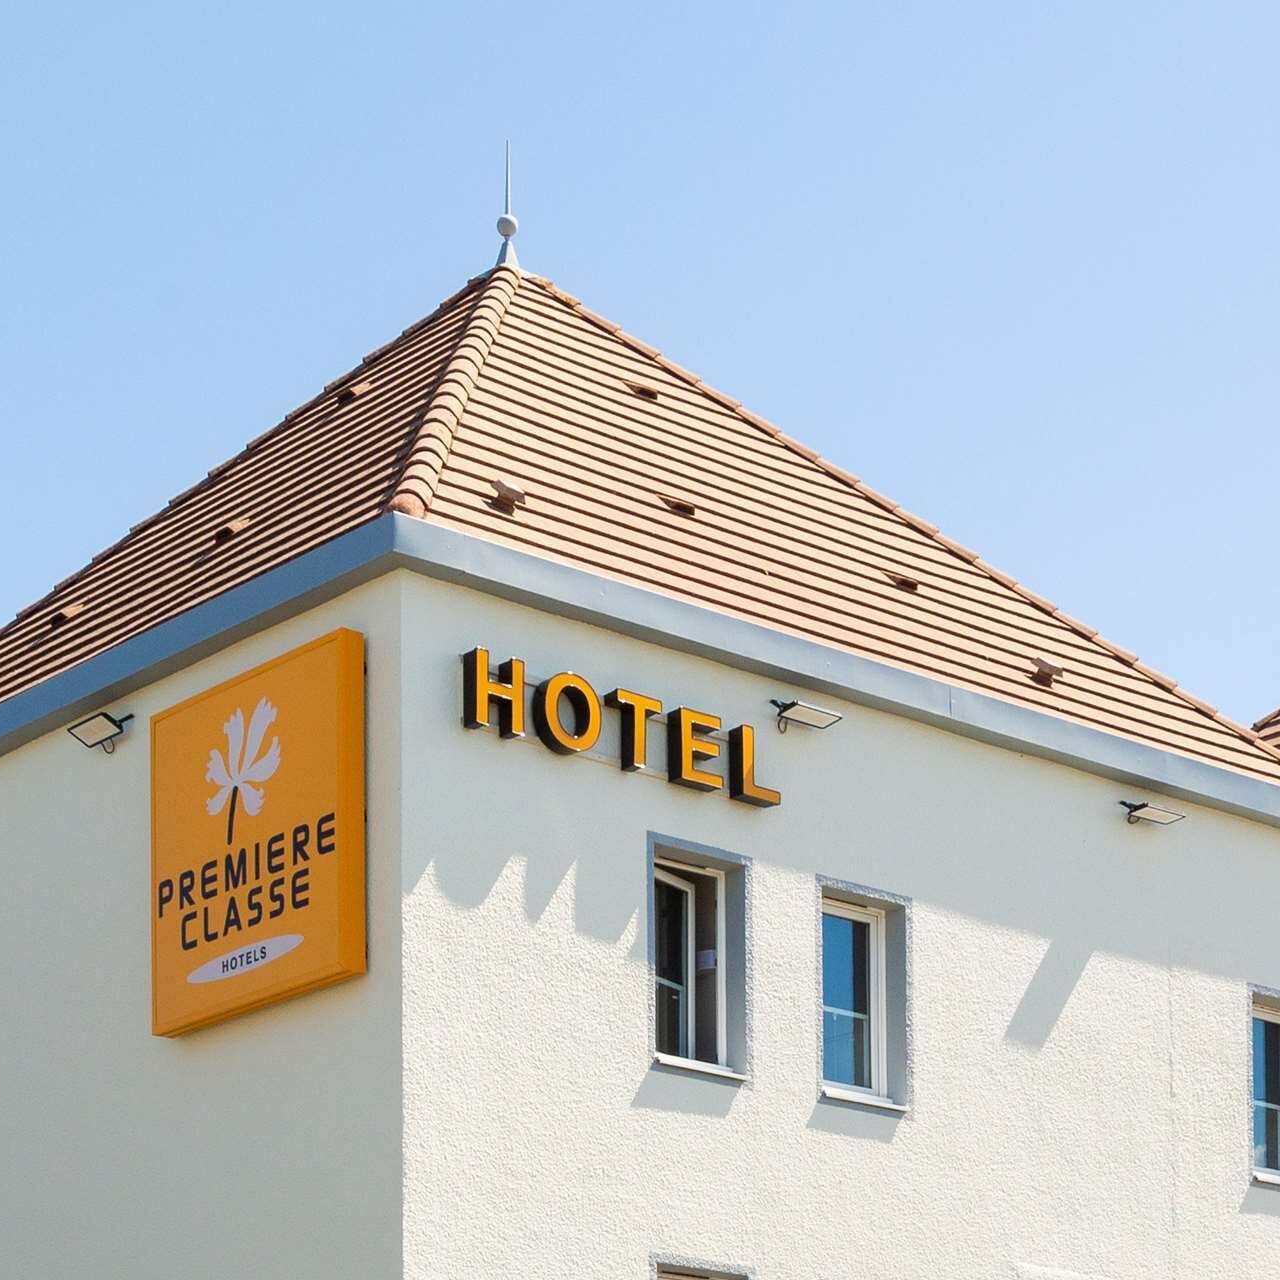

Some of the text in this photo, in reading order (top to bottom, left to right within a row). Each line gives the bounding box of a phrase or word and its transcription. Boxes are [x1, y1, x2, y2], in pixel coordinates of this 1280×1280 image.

[462, 646, 781, 808] HOTEL
[158, 811, 336, 919] PREMIERE
[181, 867, 310, 951] CLASSE
[221, 946, 268, 973] HOTELS
